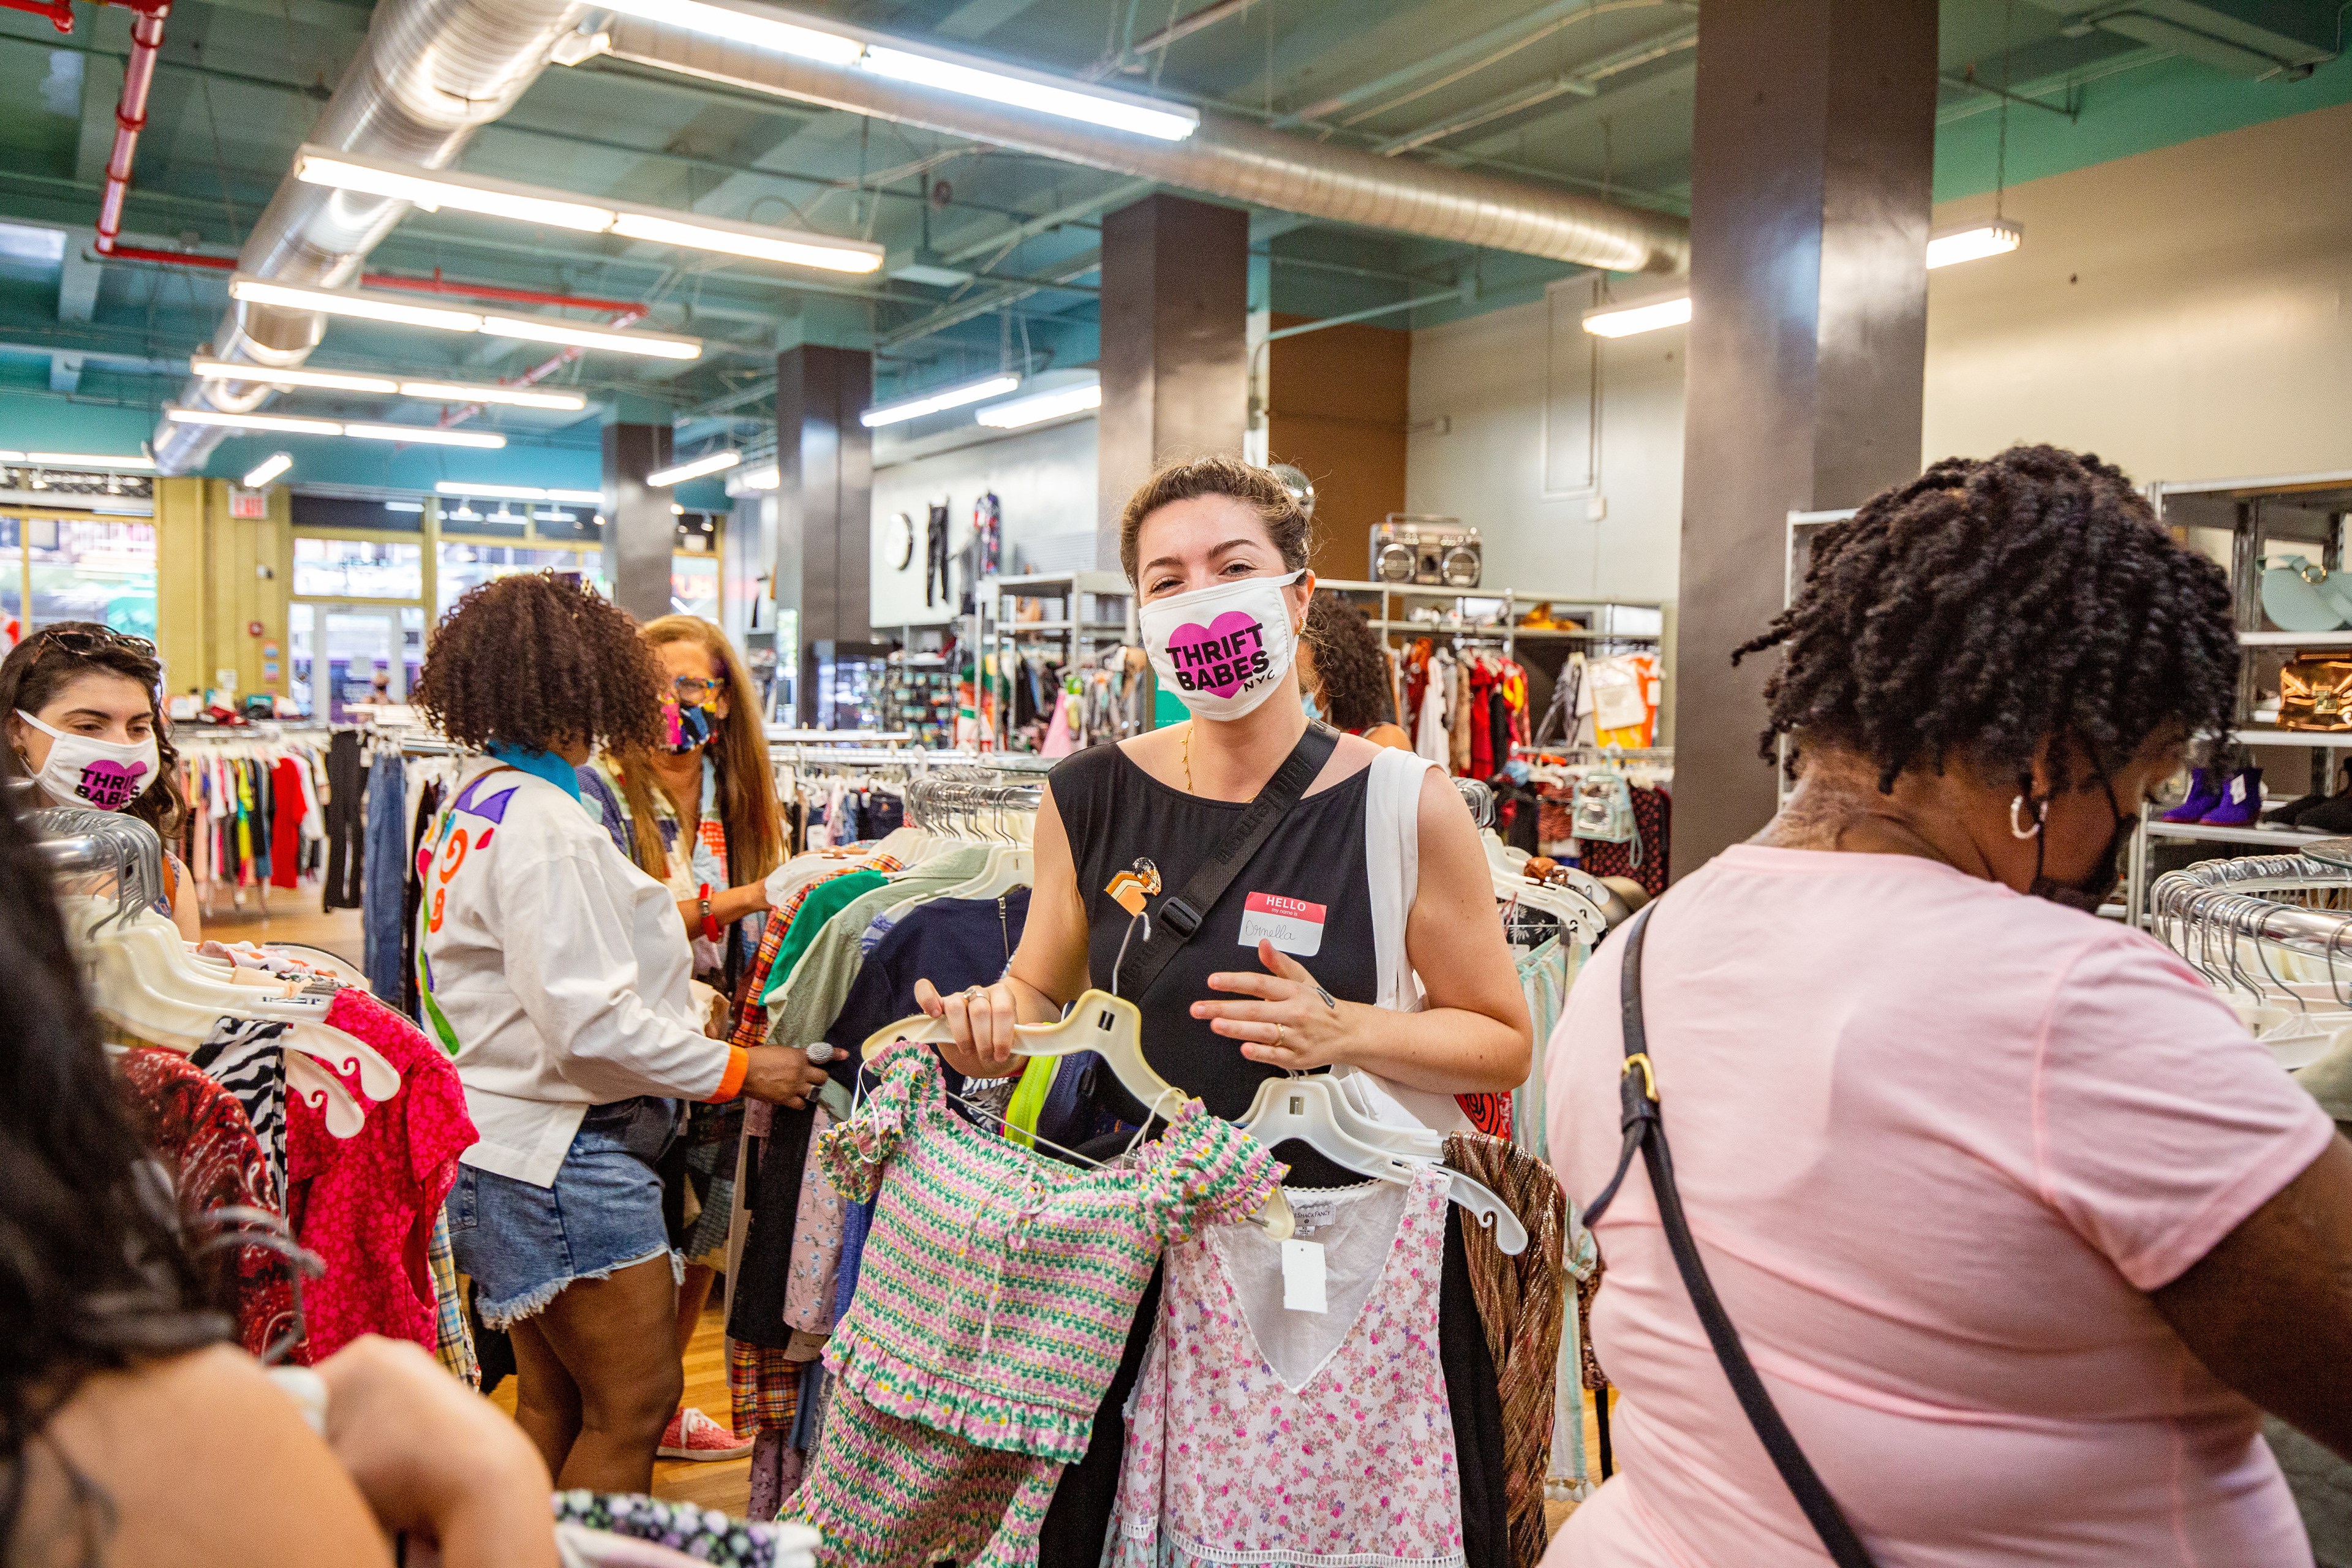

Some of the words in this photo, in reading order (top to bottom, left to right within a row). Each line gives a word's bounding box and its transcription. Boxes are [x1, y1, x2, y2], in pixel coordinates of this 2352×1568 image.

[1165, 623, 1263, 669] THRIFT
[1175, 650, 1270, 691] BABES
[1243, 669, 1275, 692] NYC
[1266, 896, 1306, 911] HELLO
